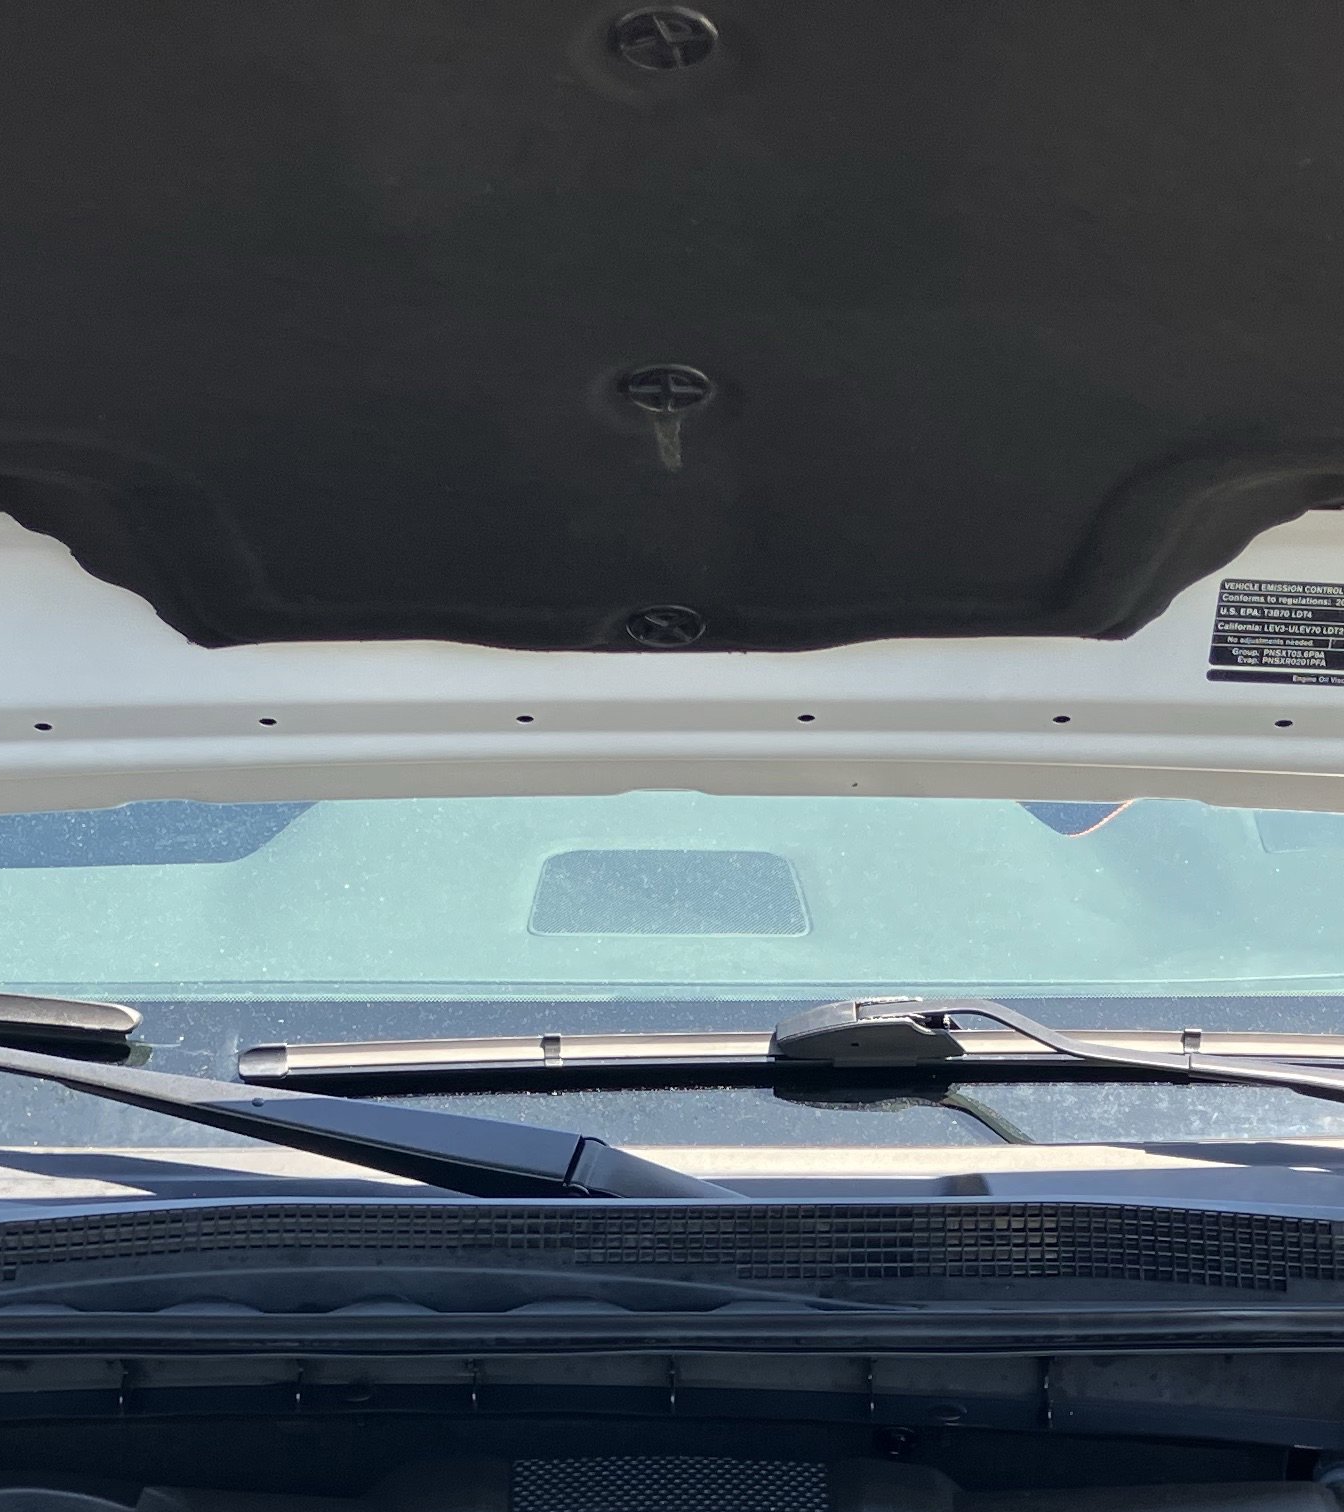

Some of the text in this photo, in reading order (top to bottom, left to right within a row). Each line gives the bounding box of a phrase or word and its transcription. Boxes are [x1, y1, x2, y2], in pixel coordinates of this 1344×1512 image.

[1224, 582, 1259, 591] VEHICLE
[1261, 583, 1303, 593] EMISSION
[1304, 585, 1344, 595] CONTROL
[1222, 593, 1264, 603] Conforms
[1267, 595, 1276, 603] to
[1220, 607, 1237, 616] U.S.
[1240, 608, 1262, 617] EPA:
[1291, 610, 1312, 619] LDT4
[1218, 621, 1344, 635] California: LEV3-ULEV70 LDT2
